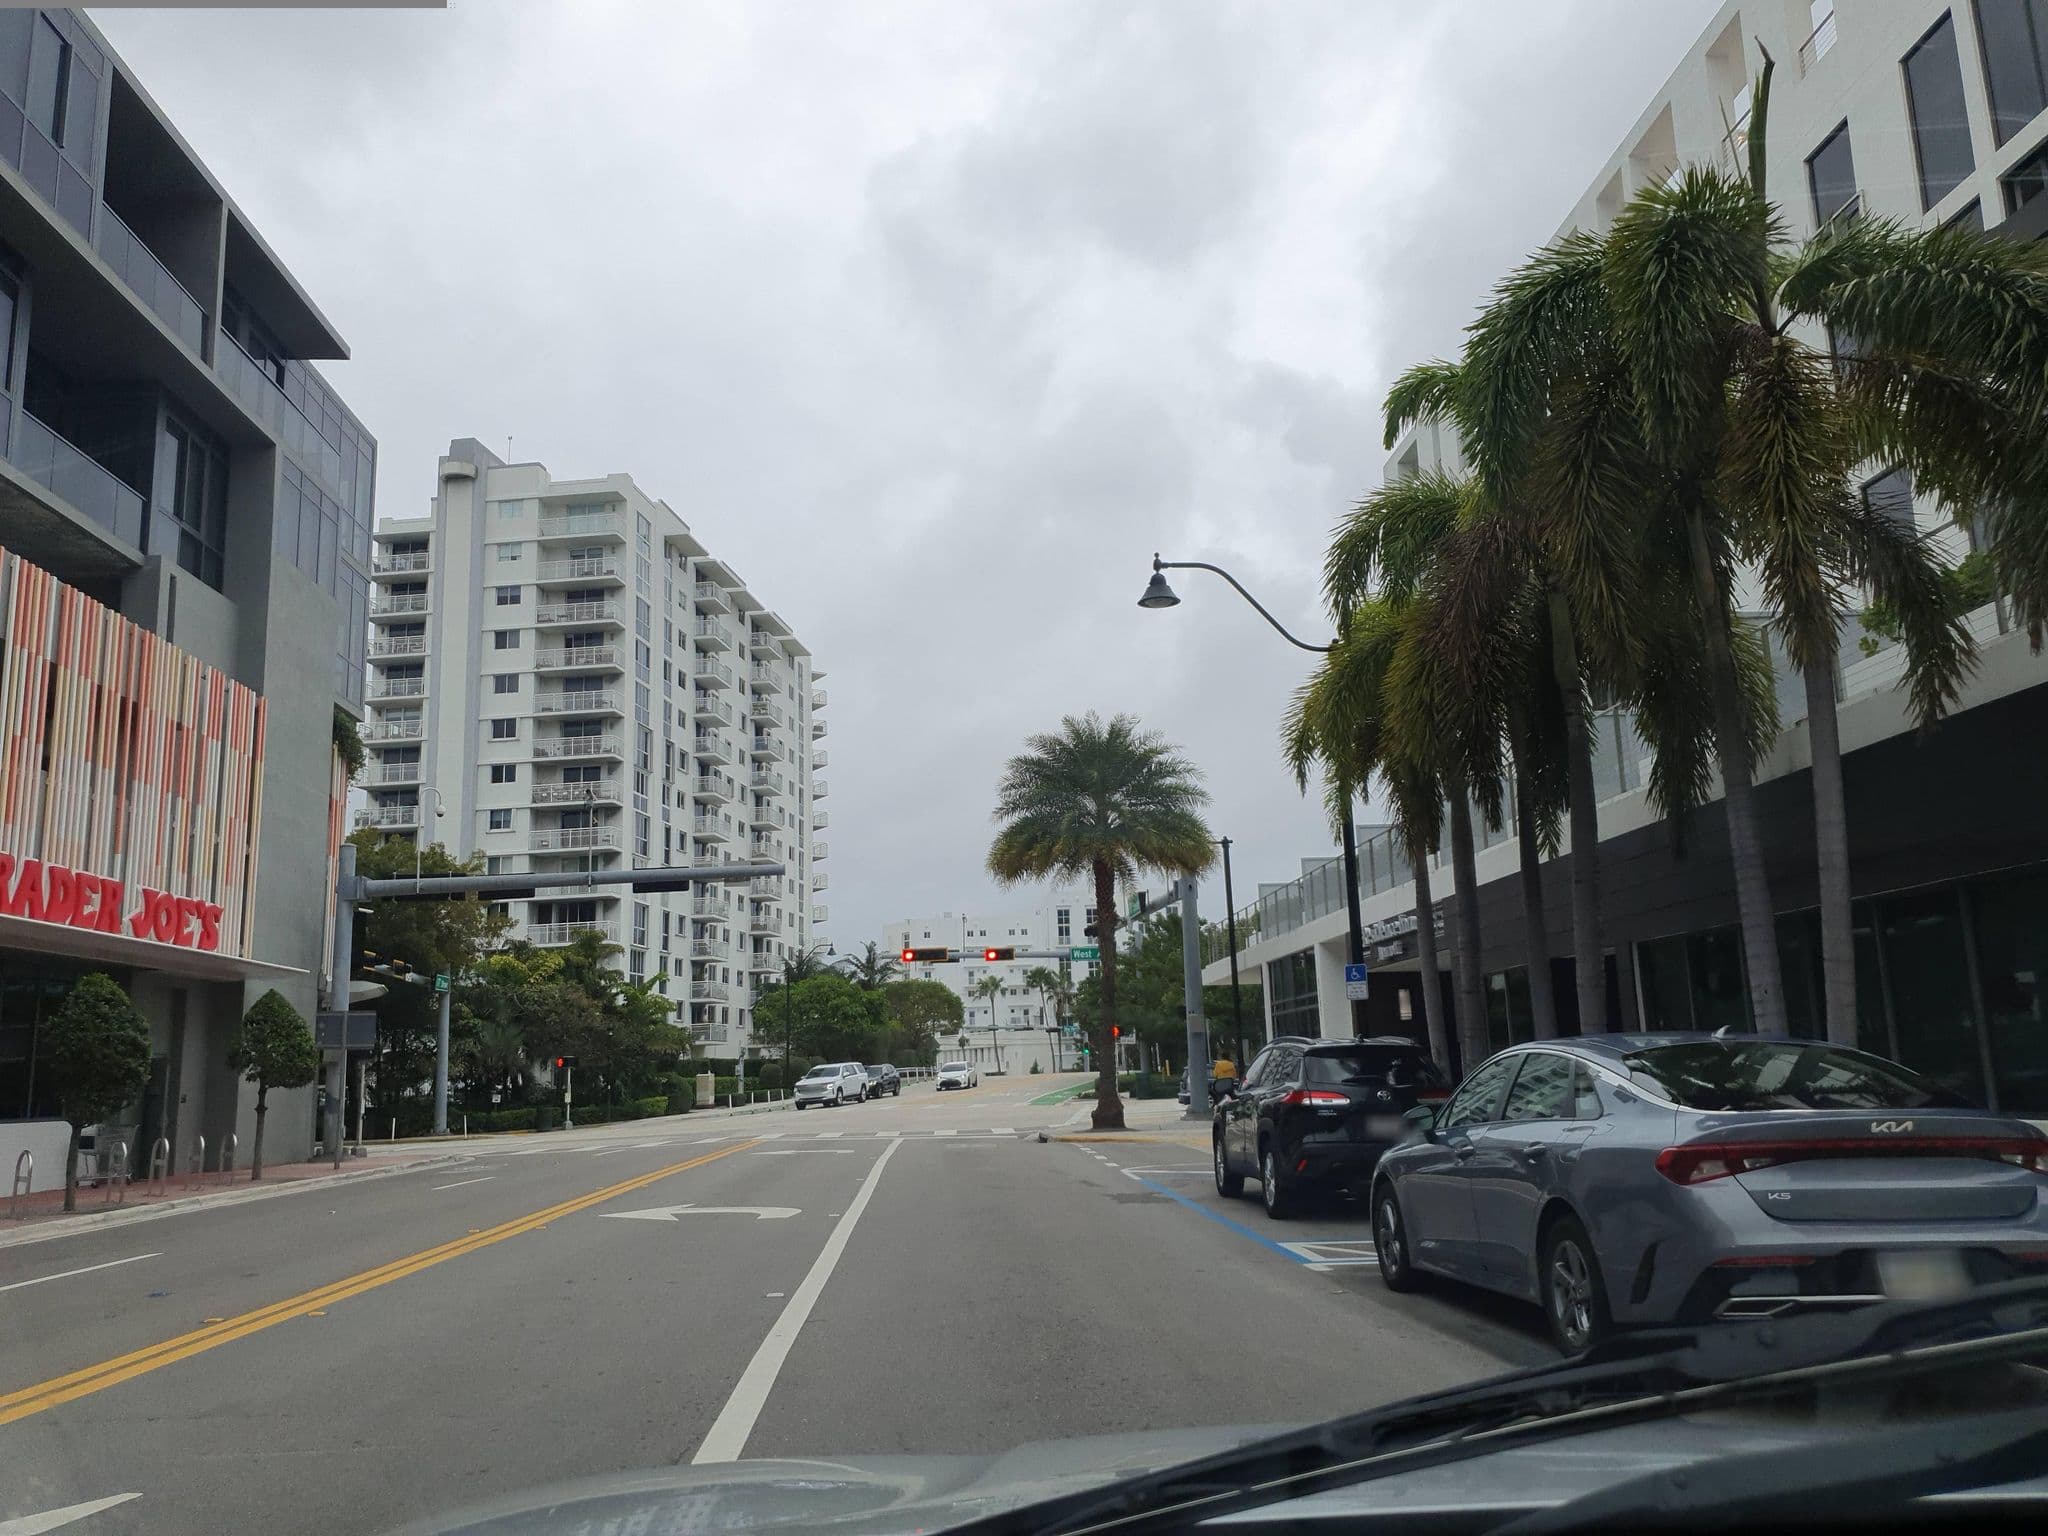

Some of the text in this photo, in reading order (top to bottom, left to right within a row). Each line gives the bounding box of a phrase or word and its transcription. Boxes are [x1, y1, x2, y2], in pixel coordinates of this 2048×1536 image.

[128, 886, 225, 951] JOE'S
[1073, 950, 1092, 959] West
[1870, 1120, 1914, 1133] KIA
[1767, 1192, 1792, 1200] K5
